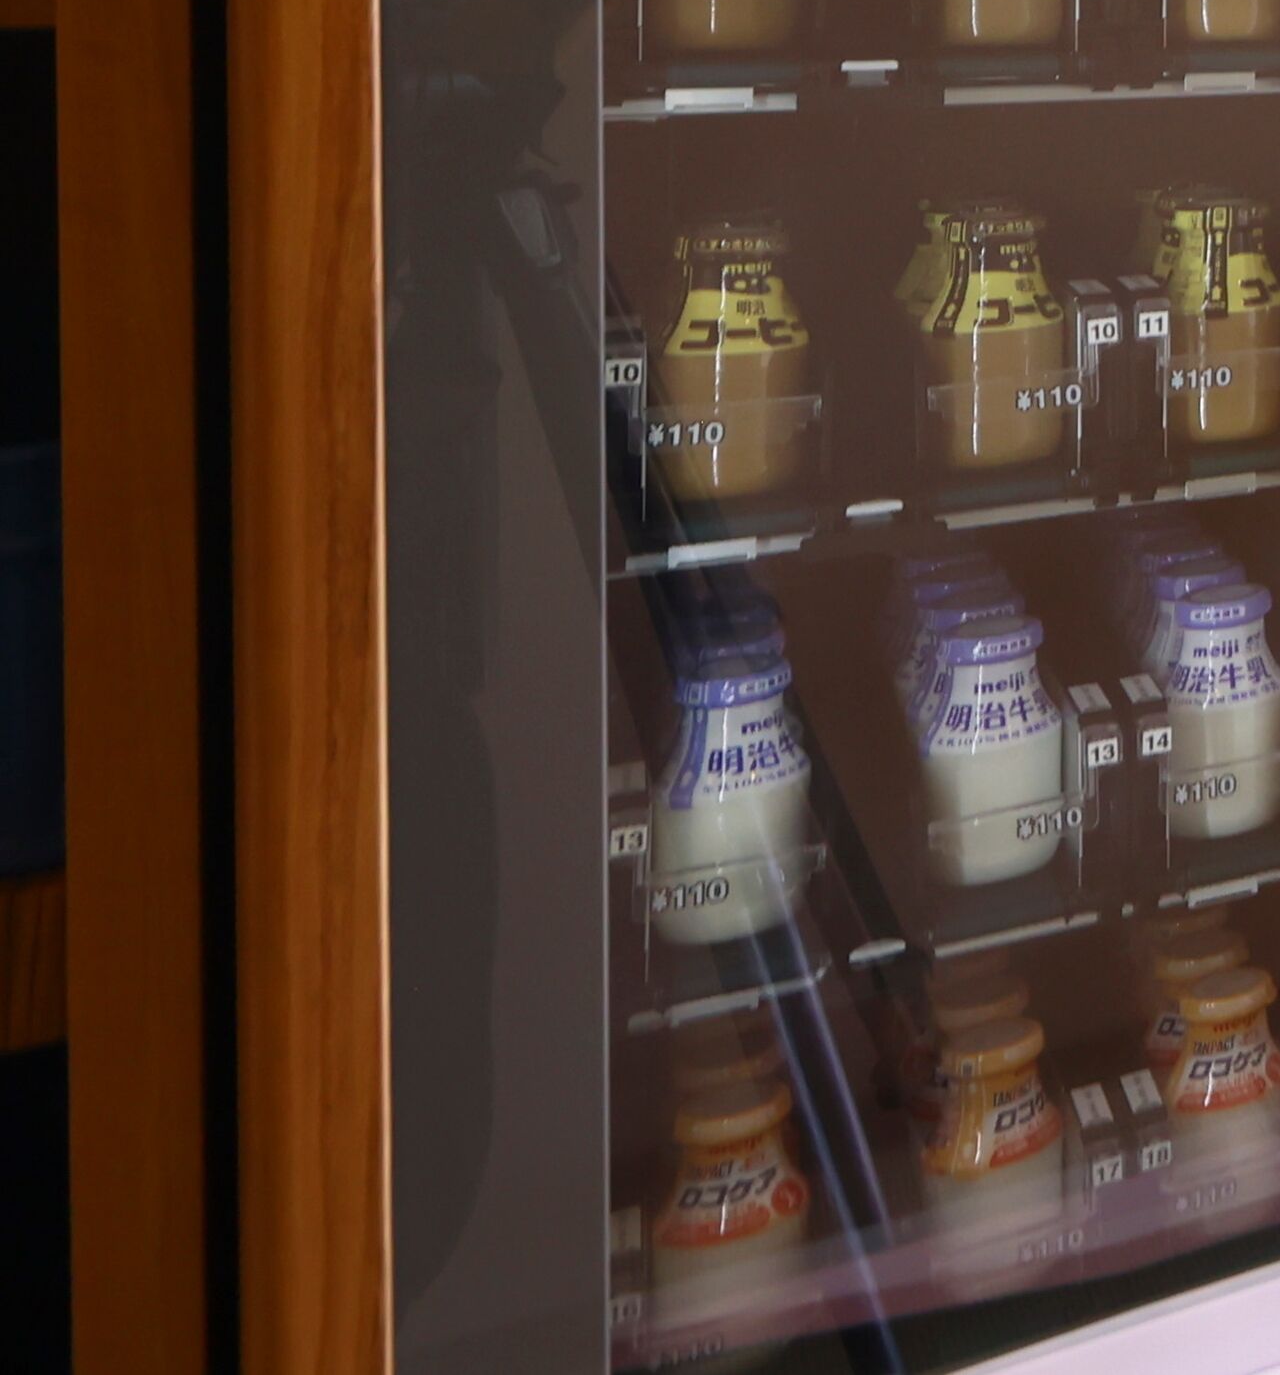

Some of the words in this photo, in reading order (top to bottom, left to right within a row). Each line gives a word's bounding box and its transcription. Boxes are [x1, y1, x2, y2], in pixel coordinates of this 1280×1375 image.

[1090, 323, 1116, 340] 10
[1143, 315, 1164, 333] 11
[609, 363, 639, 383] 10
[1171, 366, 1232, 390] ¥110
[1017, 384, 1081, 412] ¥110
[648, 422, 725, 447] ¥110
[1193, 639, 1239, 658] meiji
[974, 675, 1026, 695] meiji
[1145, 731, 1169, 750] 14
[1090, 744, 1116, 765] 13
[1174, 773, 1236, 804] ¥110
[1016, 808, 1082, 839] ¥110
[614, 832, 643, 853] 13
[651, 877, 729, 913] ¥110
